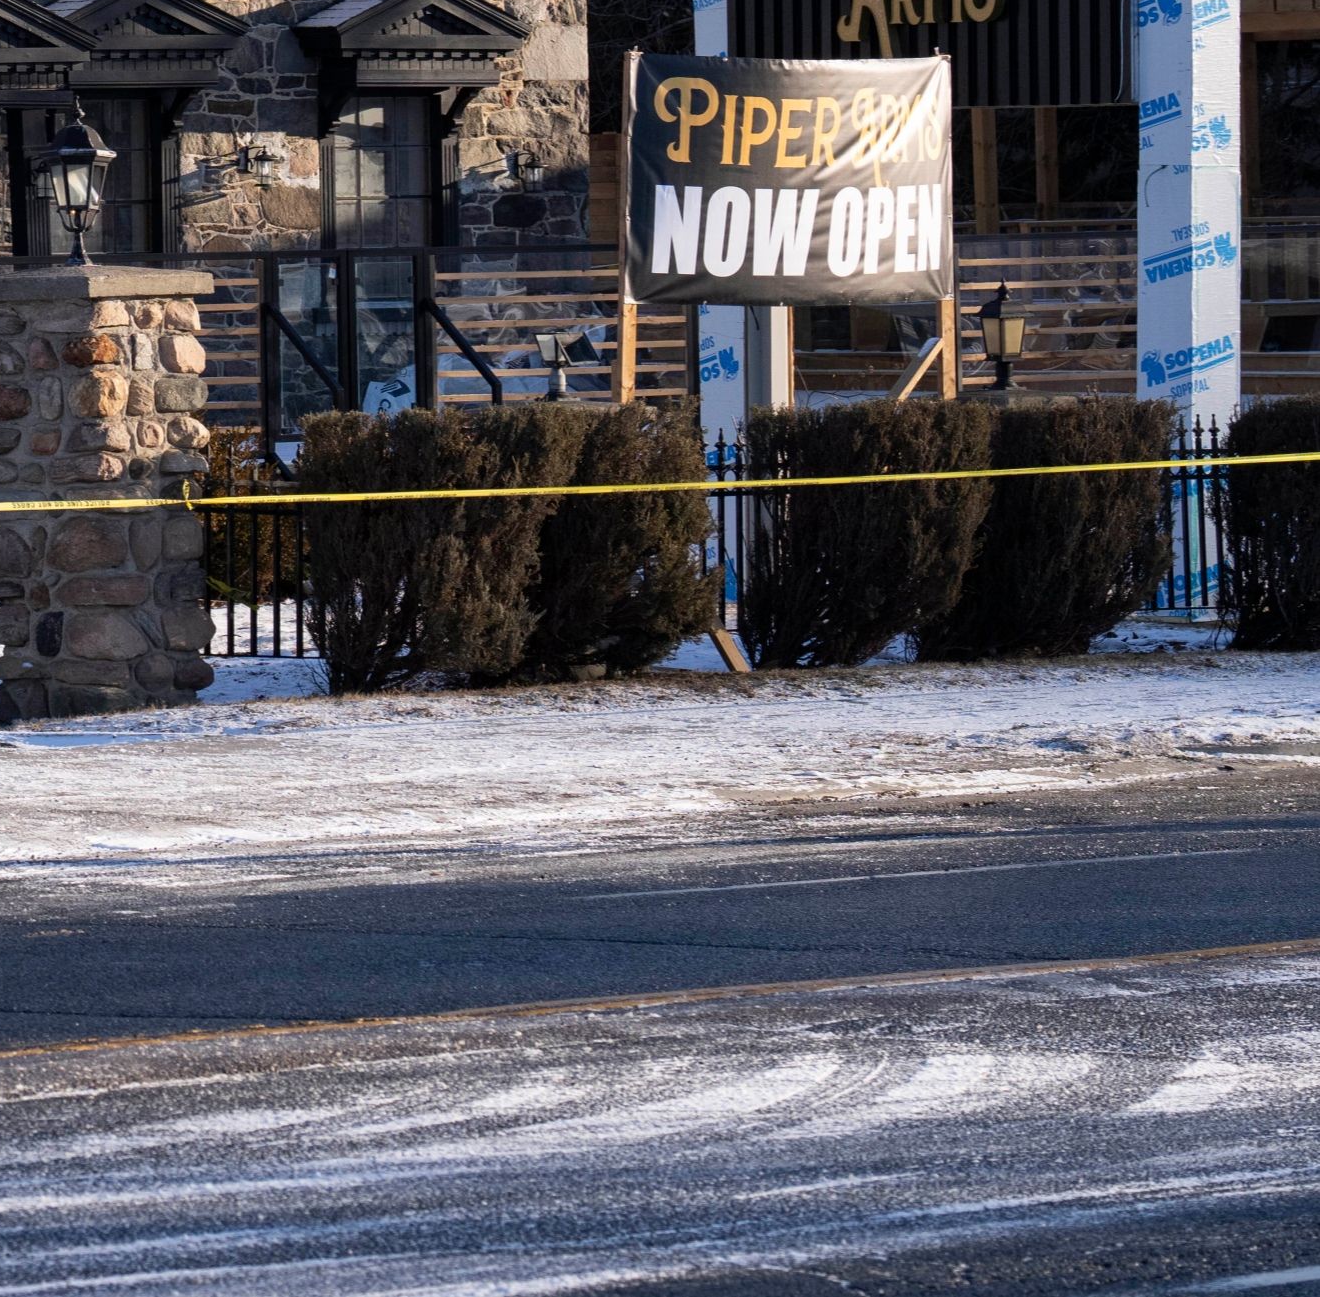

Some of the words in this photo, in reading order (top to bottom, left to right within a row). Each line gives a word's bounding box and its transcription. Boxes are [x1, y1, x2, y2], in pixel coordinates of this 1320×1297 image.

[654, 77, 842, 168] PIPER
[851, 87, 943, 188] ARMS
[651, 184, 820, 277] NOW
[827, 184, 941, 277] OPEN
